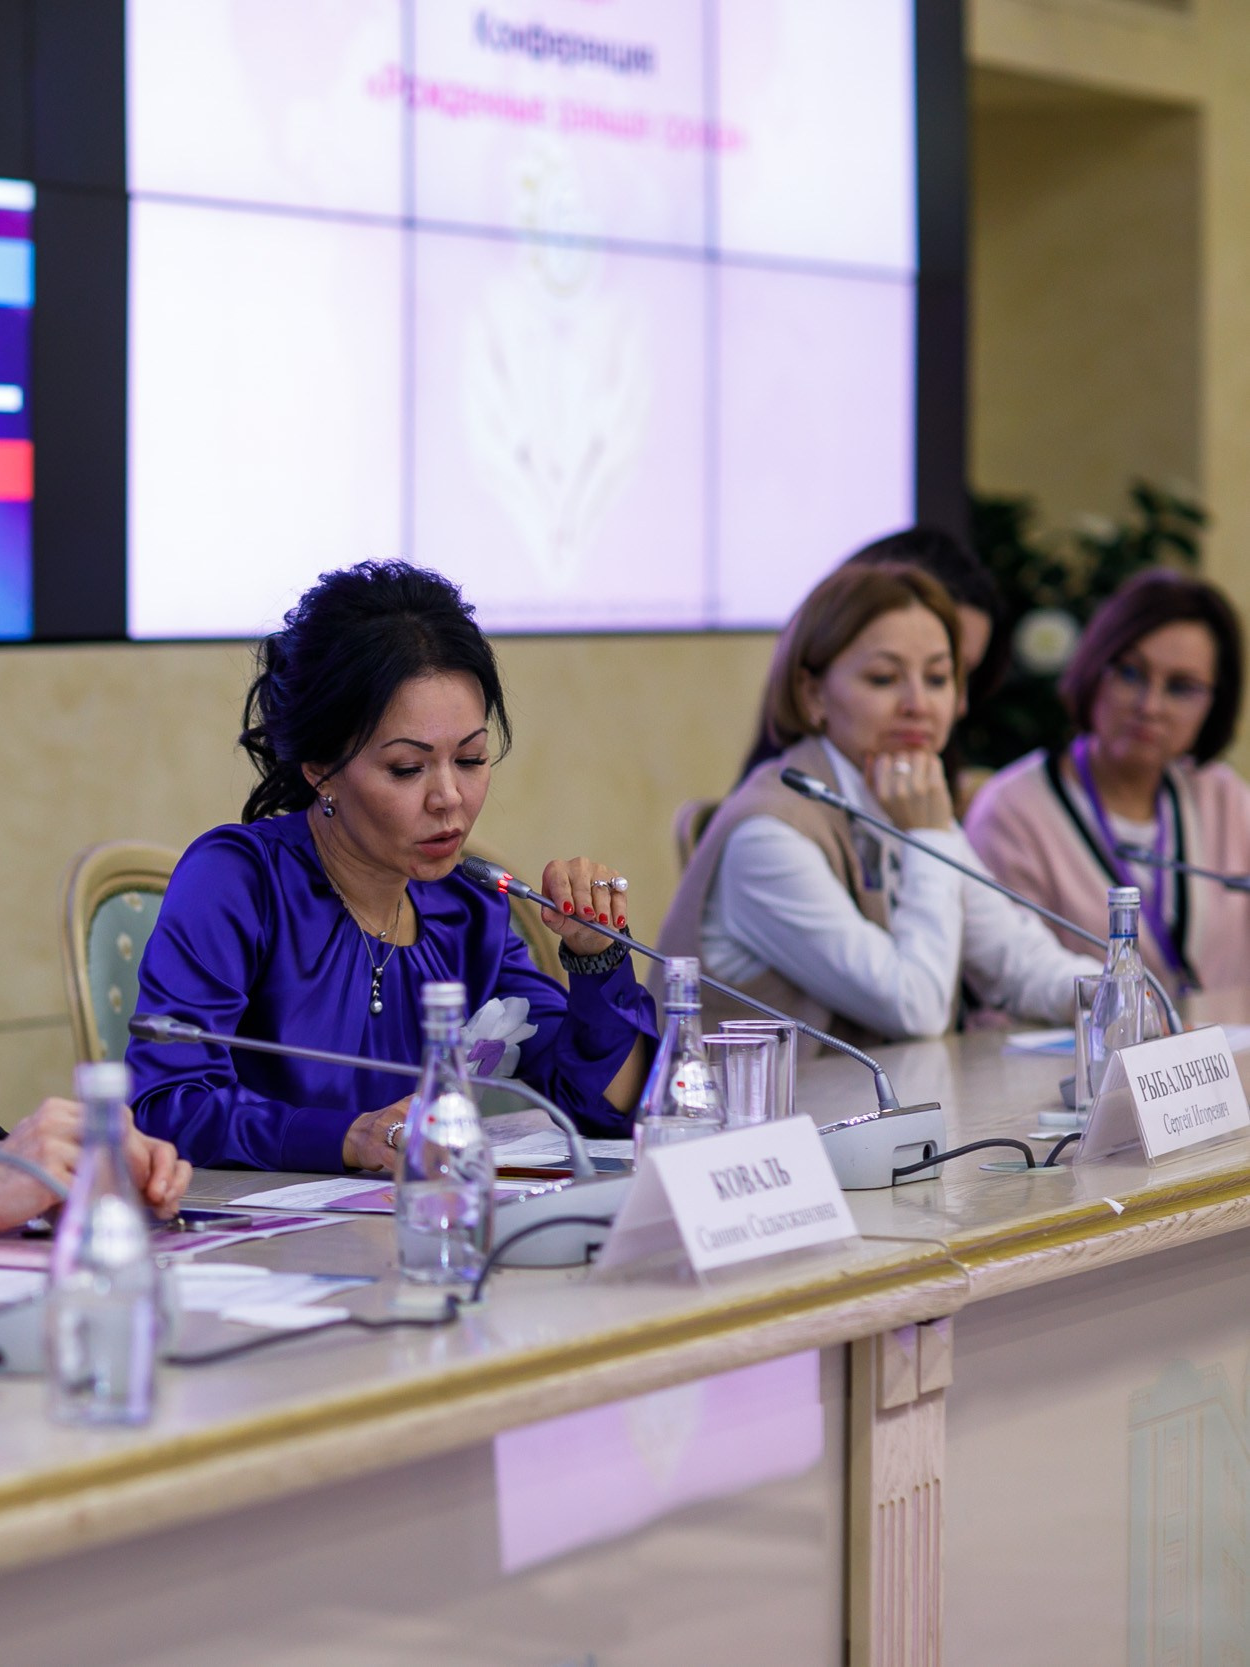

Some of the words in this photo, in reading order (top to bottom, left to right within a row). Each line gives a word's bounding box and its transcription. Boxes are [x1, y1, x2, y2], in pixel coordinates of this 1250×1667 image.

[1137, 1052, 1230, 1102] РЫБАЛЬЧЕНКО
[1163, 1106, 1193, 1135] Сергей
[1191, 1101, 1230, 1127] Игоревич
[710, 1157, 791, 1200] КОВАЛЬ
